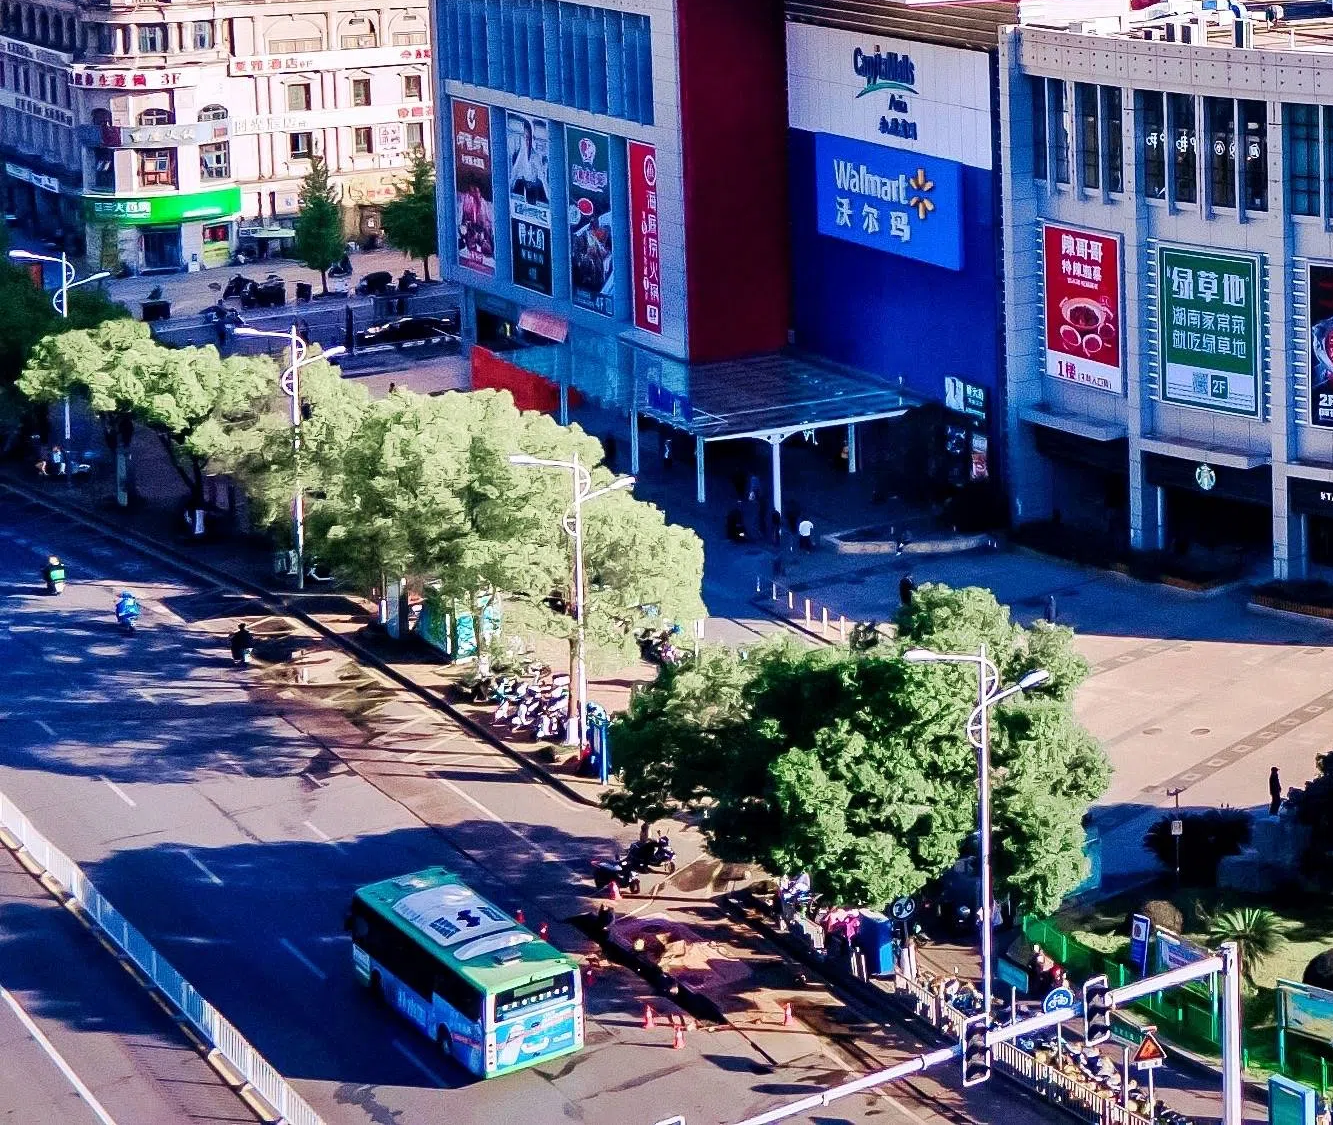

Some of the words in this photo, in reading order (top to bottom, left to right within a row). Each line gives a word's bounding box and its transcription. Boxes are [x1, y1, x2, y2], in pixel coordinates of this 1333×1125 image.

[833, 159, 909, 205] Walmart
[835, 196, 911, 242] 沃尔玛
[1171, 266, 1246, 307] 绿草地
[1172, 305, 1246, 335] 湖南家常菜
[1172, 329, 1247, 359] 就吃绿草地
[1212, 379, 1226, 394] 2F
